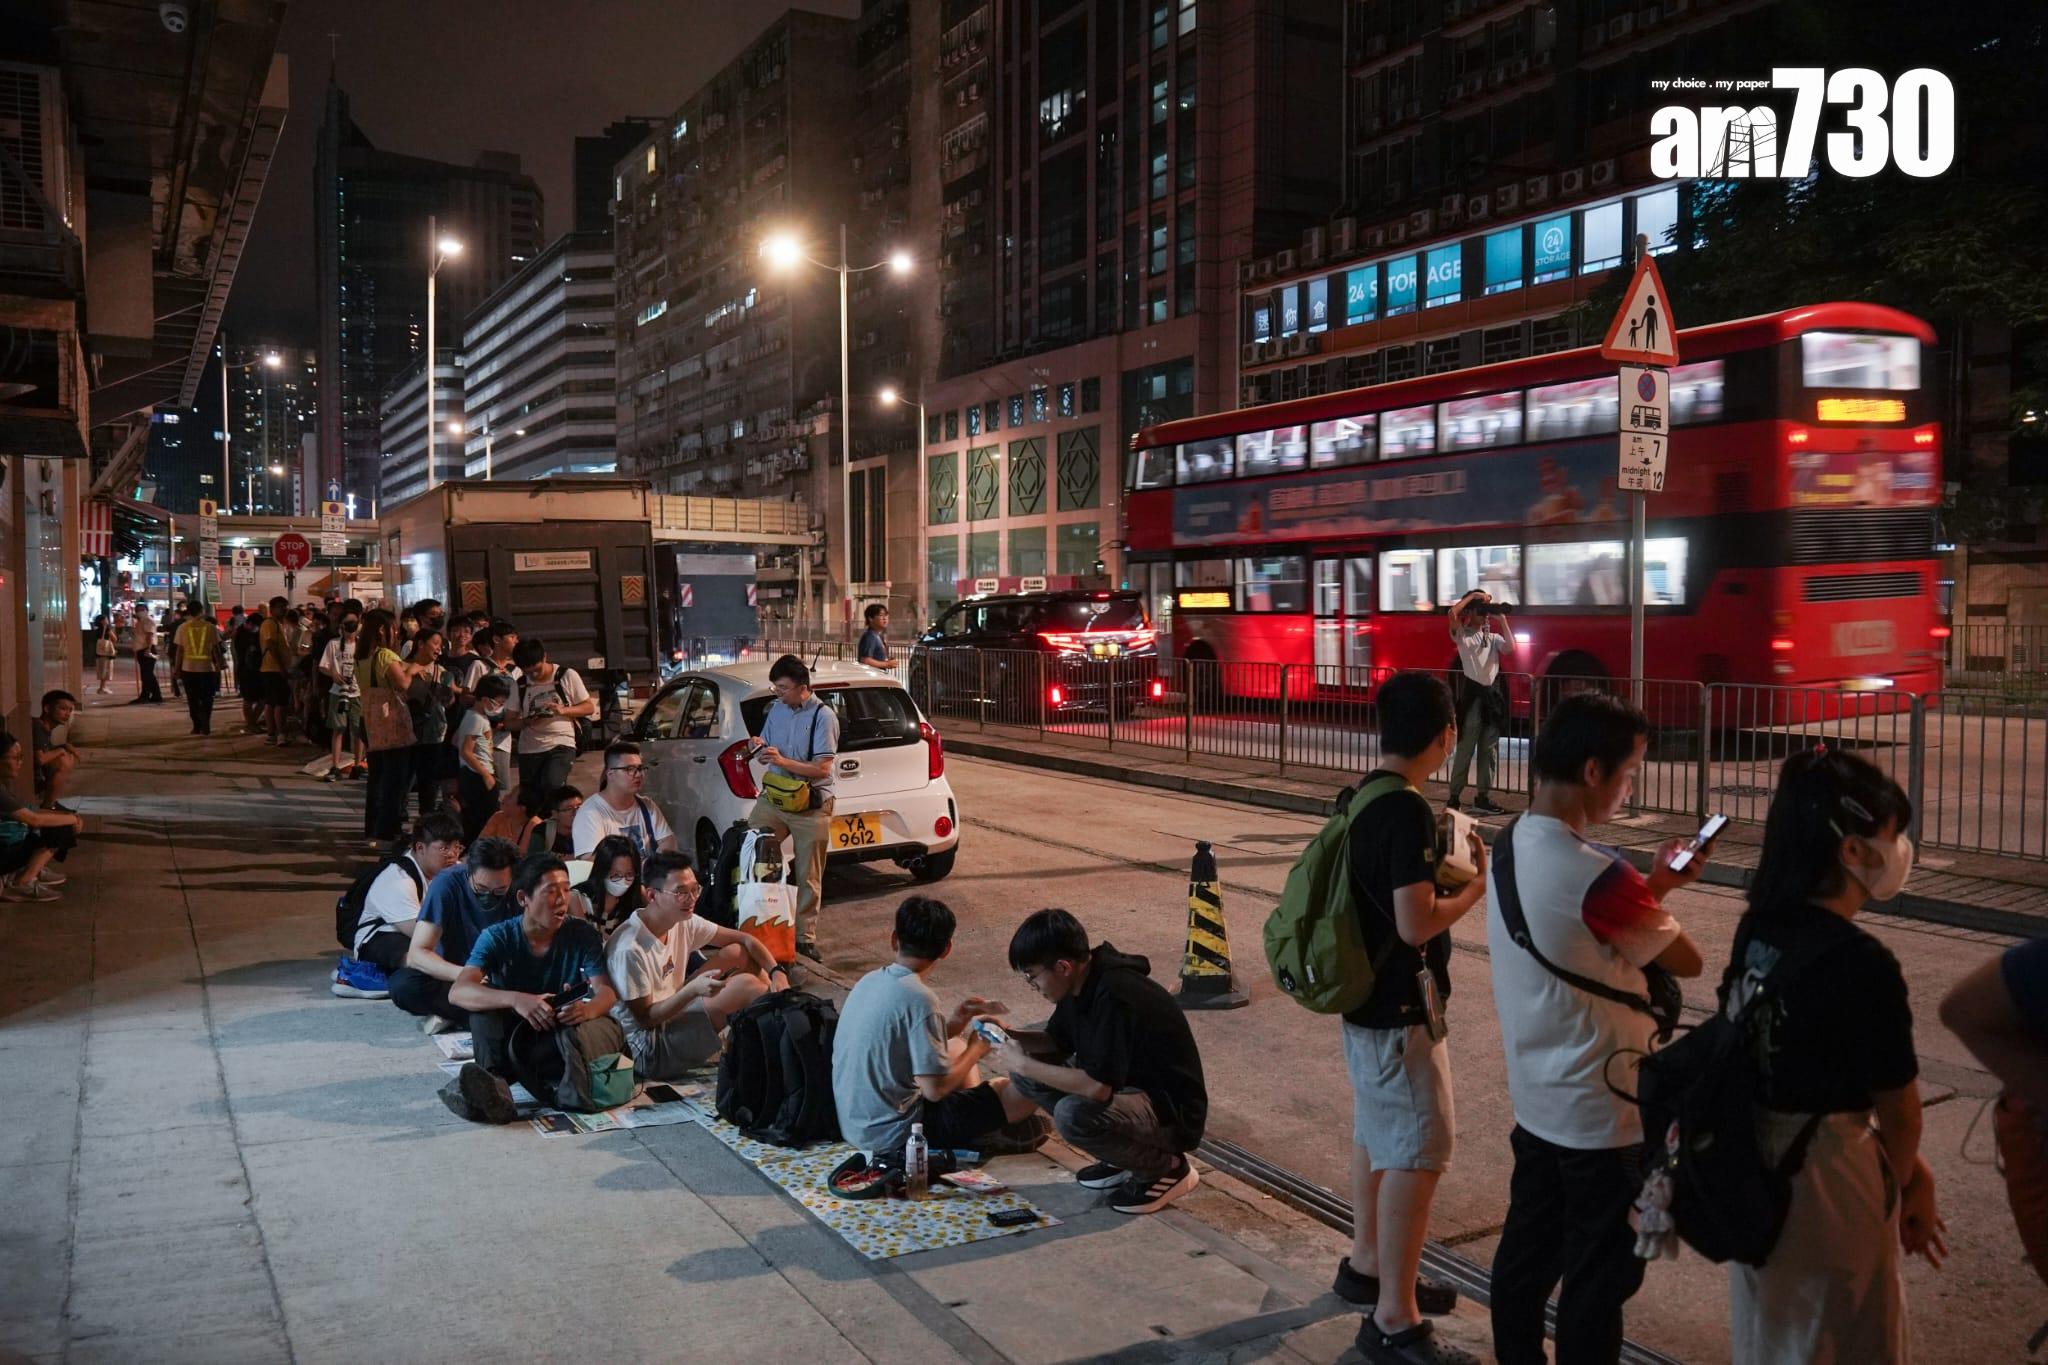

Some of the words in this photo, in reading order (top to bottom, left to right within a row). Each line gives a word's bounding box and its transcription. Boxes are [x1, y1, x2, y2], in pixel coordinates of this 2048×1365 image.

[1546, 234, 1559, 248] 24
[1535, 250, 1571, 266] STORAGE
[1349, 283, 1365, 303] 24
[1369, 259, 1462, 298] STORAGE
[1629, 446, 1645, 457] 上午
[1653, 440, 1660, 458] 7
[1621, 466, 1651, 476] midnight
[1627, 477, 1644, 488] 午夜
[1653, 471, 1663, 490] 12
[280, 541, 304, 551] STOP
[287, 554, 298, 565] 停
[845, 818, 866, 832] YA
[839, 830, 875, 847] 9612
